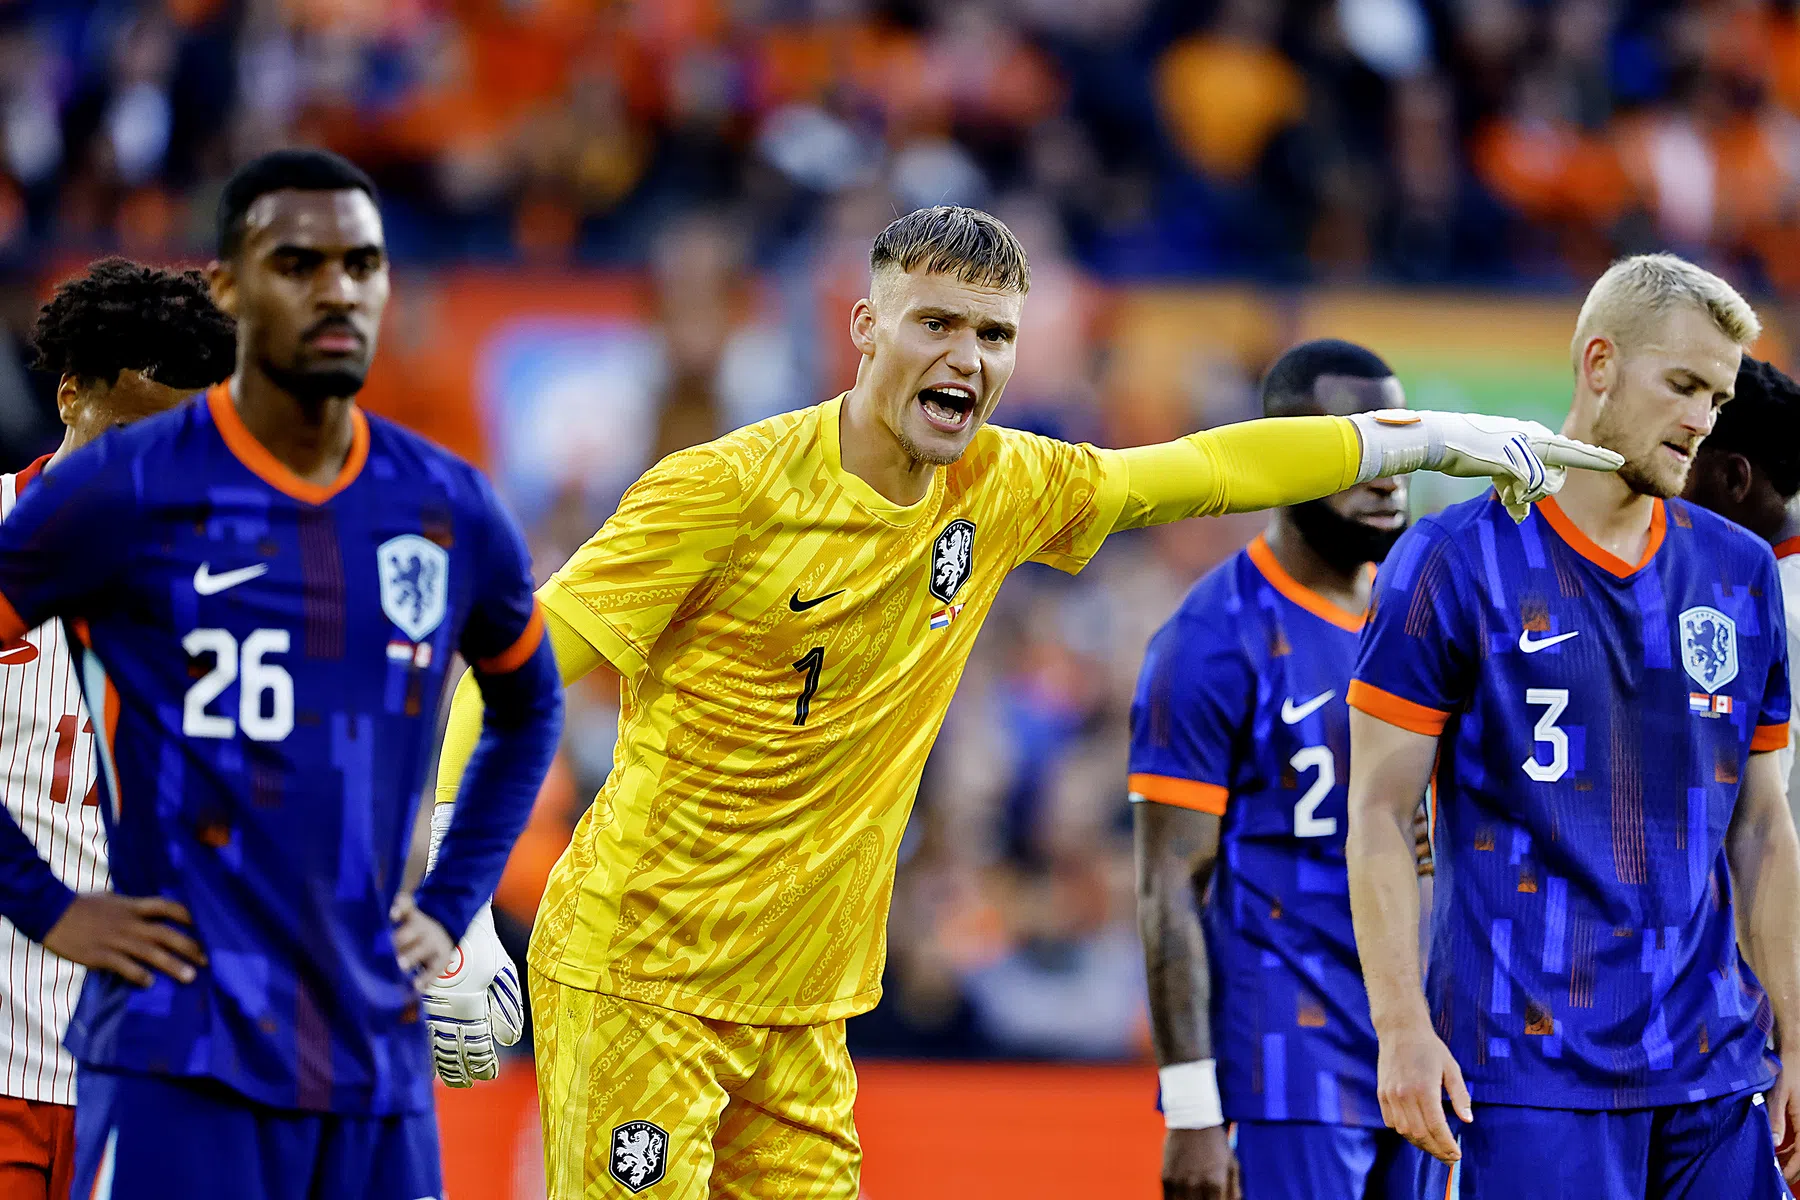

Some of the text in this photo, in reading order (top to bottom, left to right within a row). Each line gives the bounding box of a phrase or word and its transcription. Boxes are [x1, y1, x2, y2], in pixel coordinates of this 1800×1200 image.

[181, 627, 295, 741] 26
[791, 646, 825, 726] 1
[1522, 688, 1569, 783] 3
[1289, 745, 1337, 838] 2
